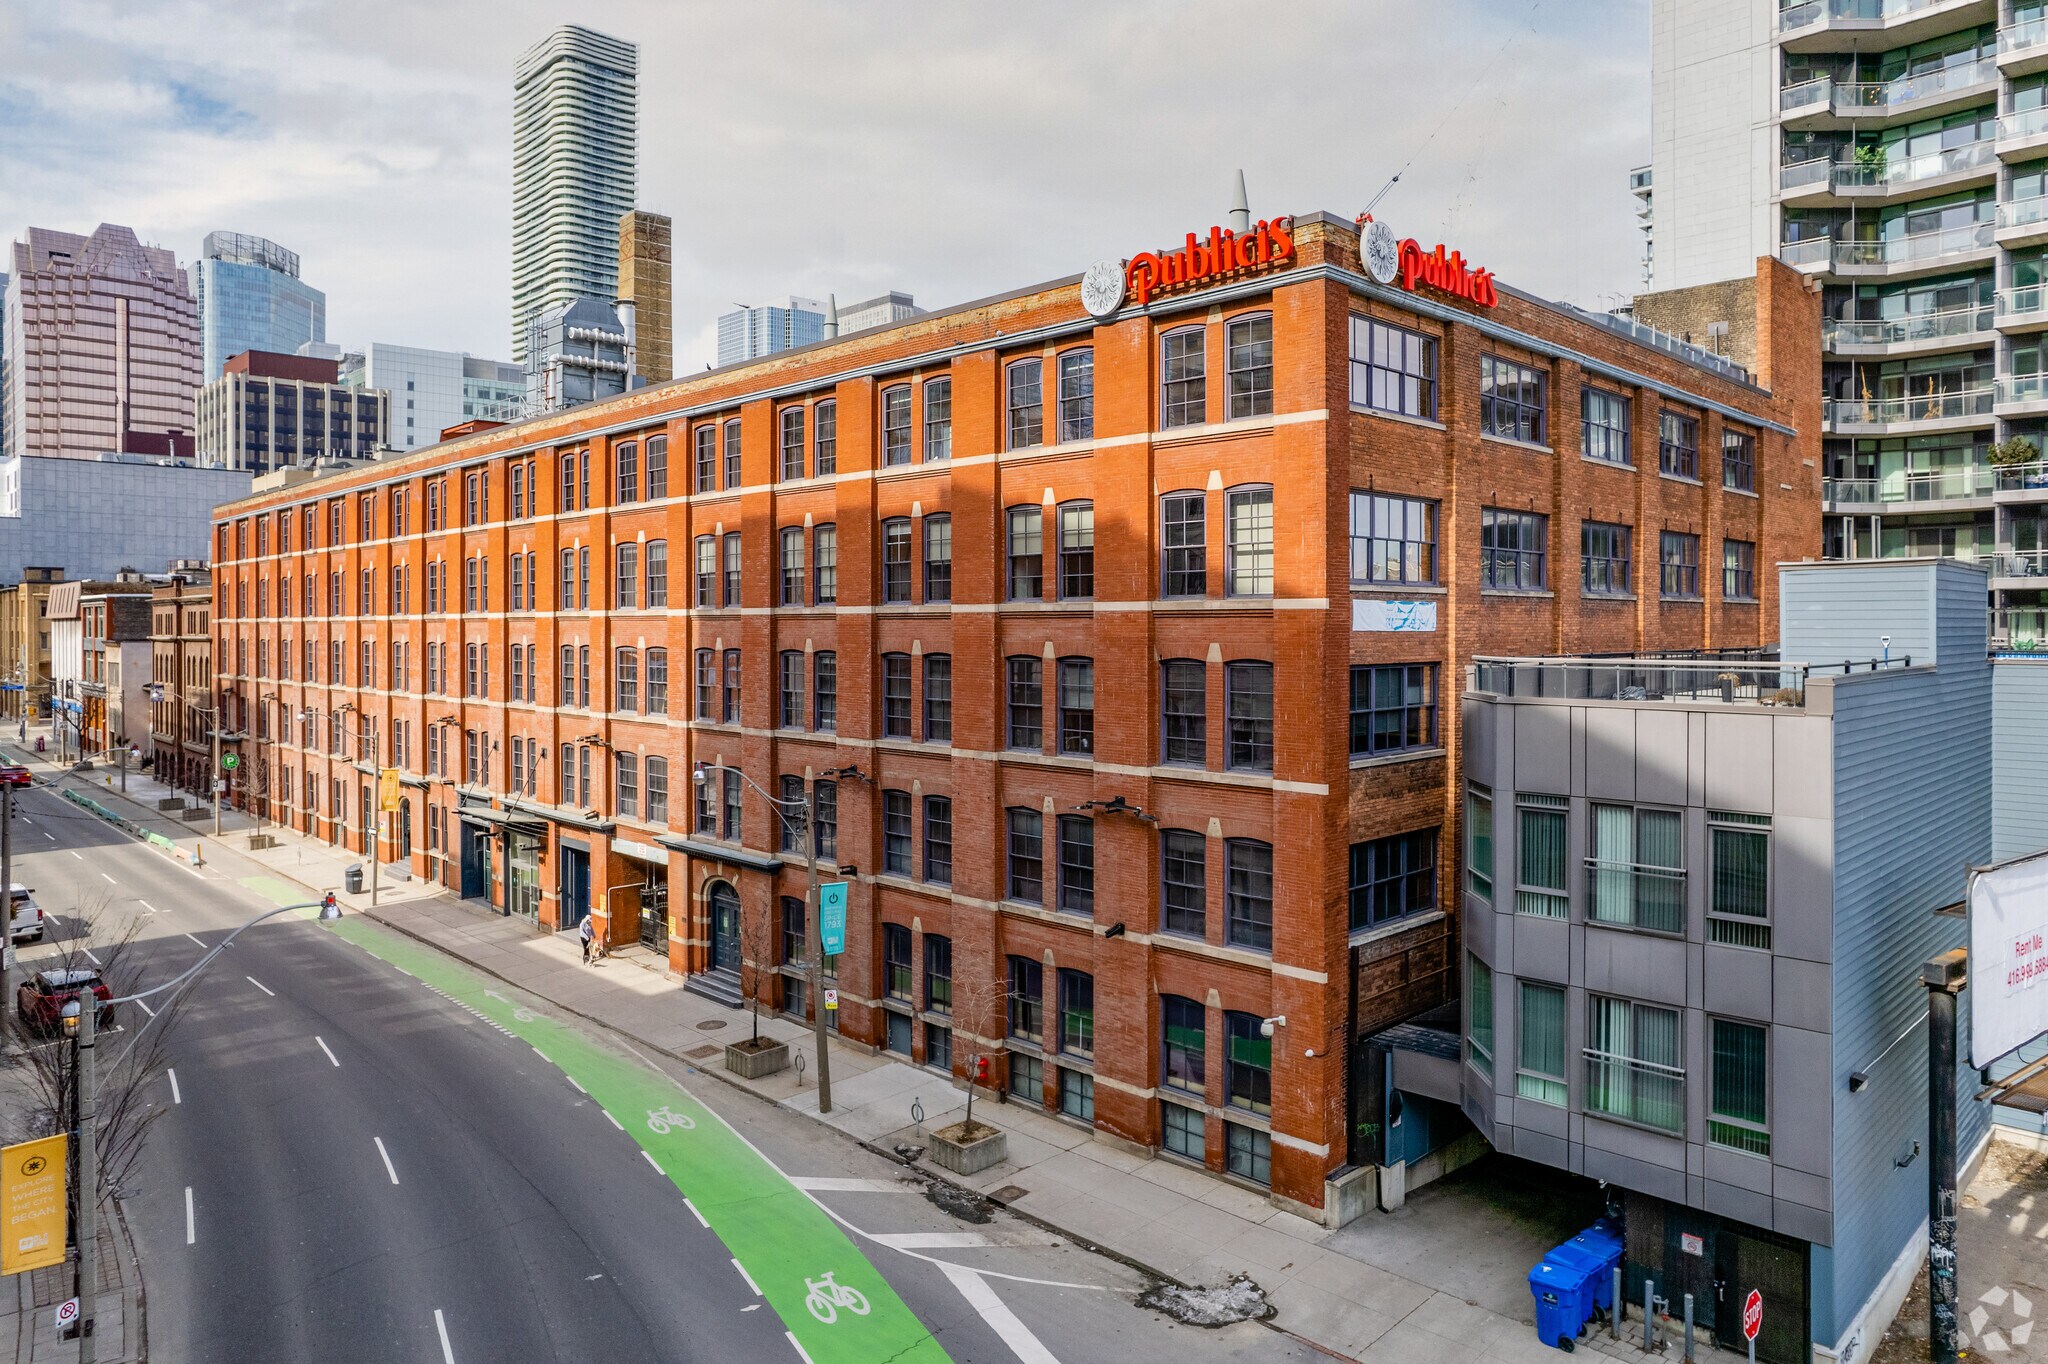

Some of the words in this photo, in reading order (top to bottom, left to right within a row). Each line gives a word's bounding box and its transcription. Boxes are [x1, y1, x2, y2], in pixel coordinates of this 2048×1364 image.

[1127, 216, 1294, 304] Publicis
[1398, 238, 1498, 308] Publicis
[824, 919, 842, 929] 1793
[2015, 938, 2032, 958] Rent
[2033, 934, 2043, 951] Me
[12, 1173, 56, 1192] EXPLORE
[12, 1184, 55, 1202] WHERE
[12, 1201, 31, 1213] THE
[33, 1195, 55, 1206] CITY
[12, 1206, 57, 1225] BEGAN
[1745, 1301, 1760, 1329] STOP
